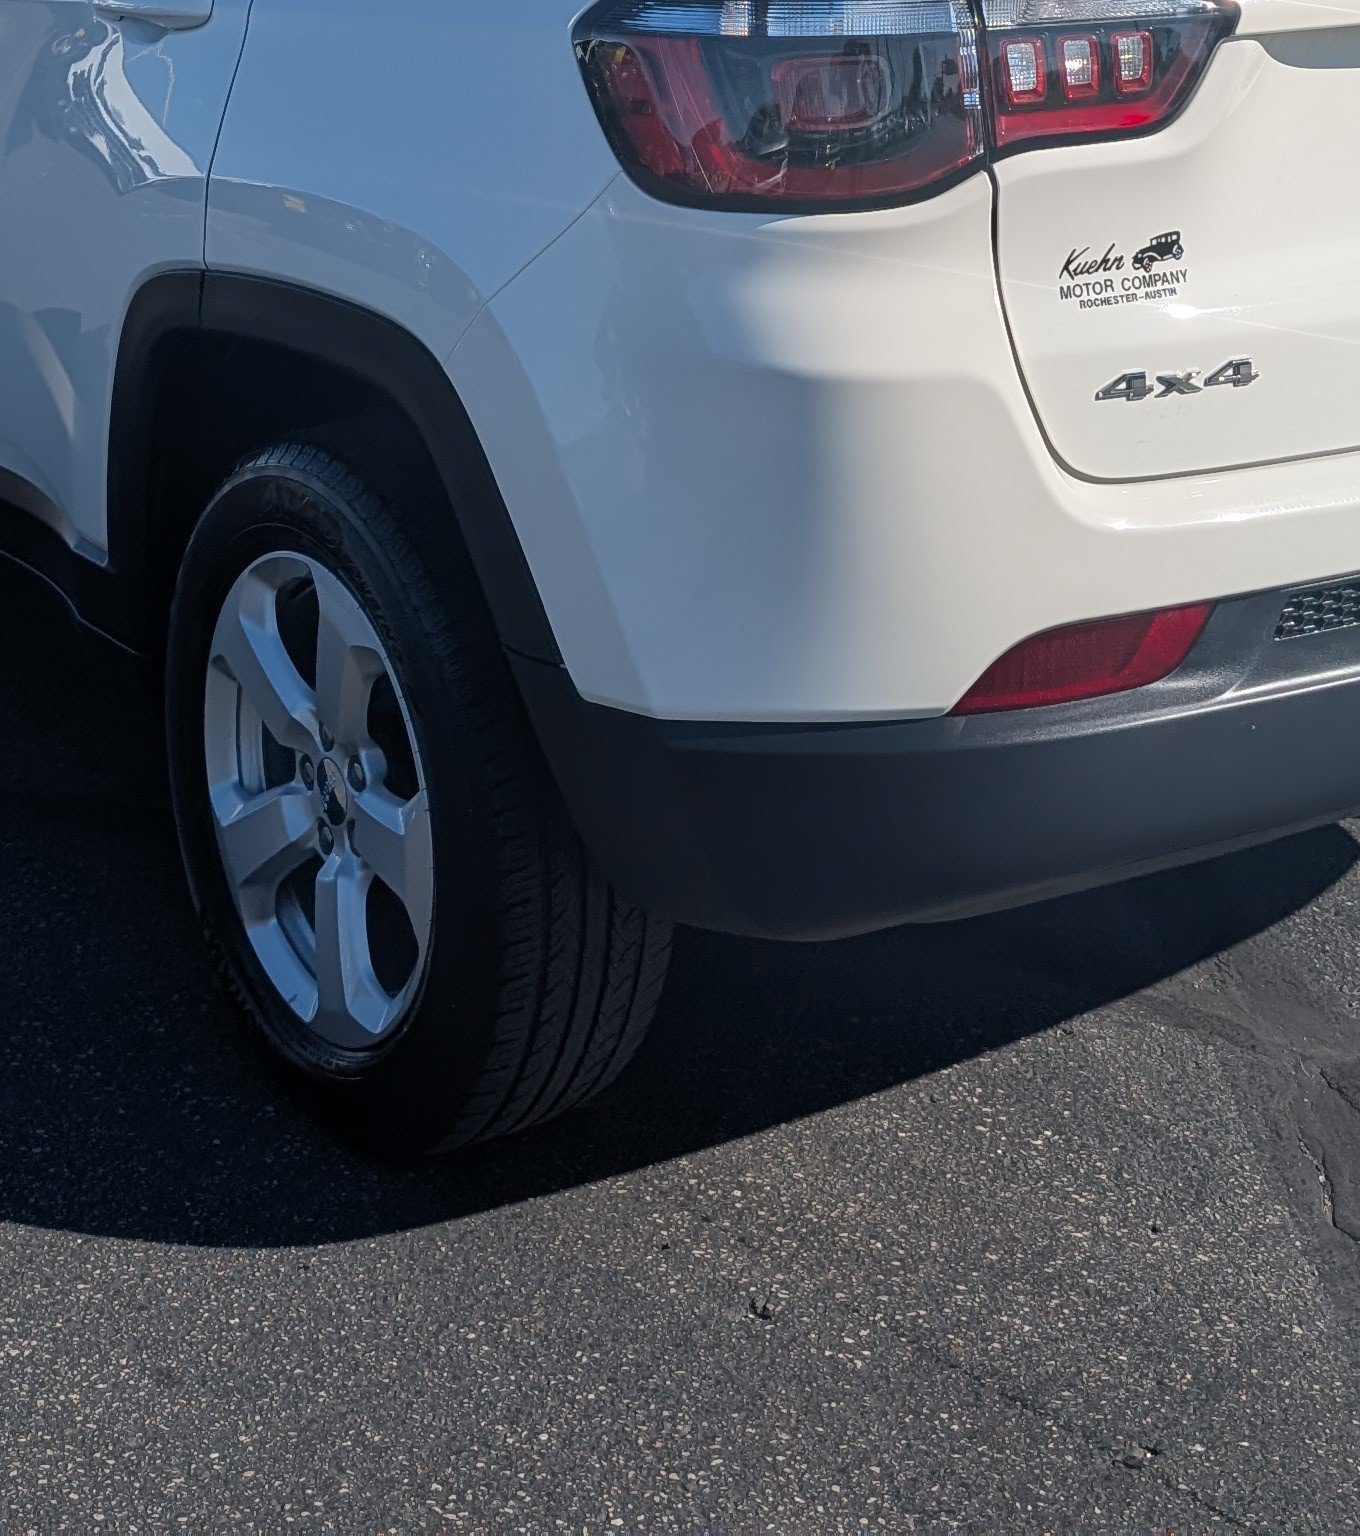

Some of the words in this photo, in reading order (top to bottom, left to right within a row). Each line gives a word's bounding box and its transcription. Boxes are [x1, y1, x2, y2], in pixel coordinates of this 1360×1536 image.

[1059, 243, 1125, 281] Kuehn
[1059, 279, 1115, 300] MOTOR
[1121, 269, 1188, 291] COMPANY
[1095, 356, 1259, 402] 4x4
